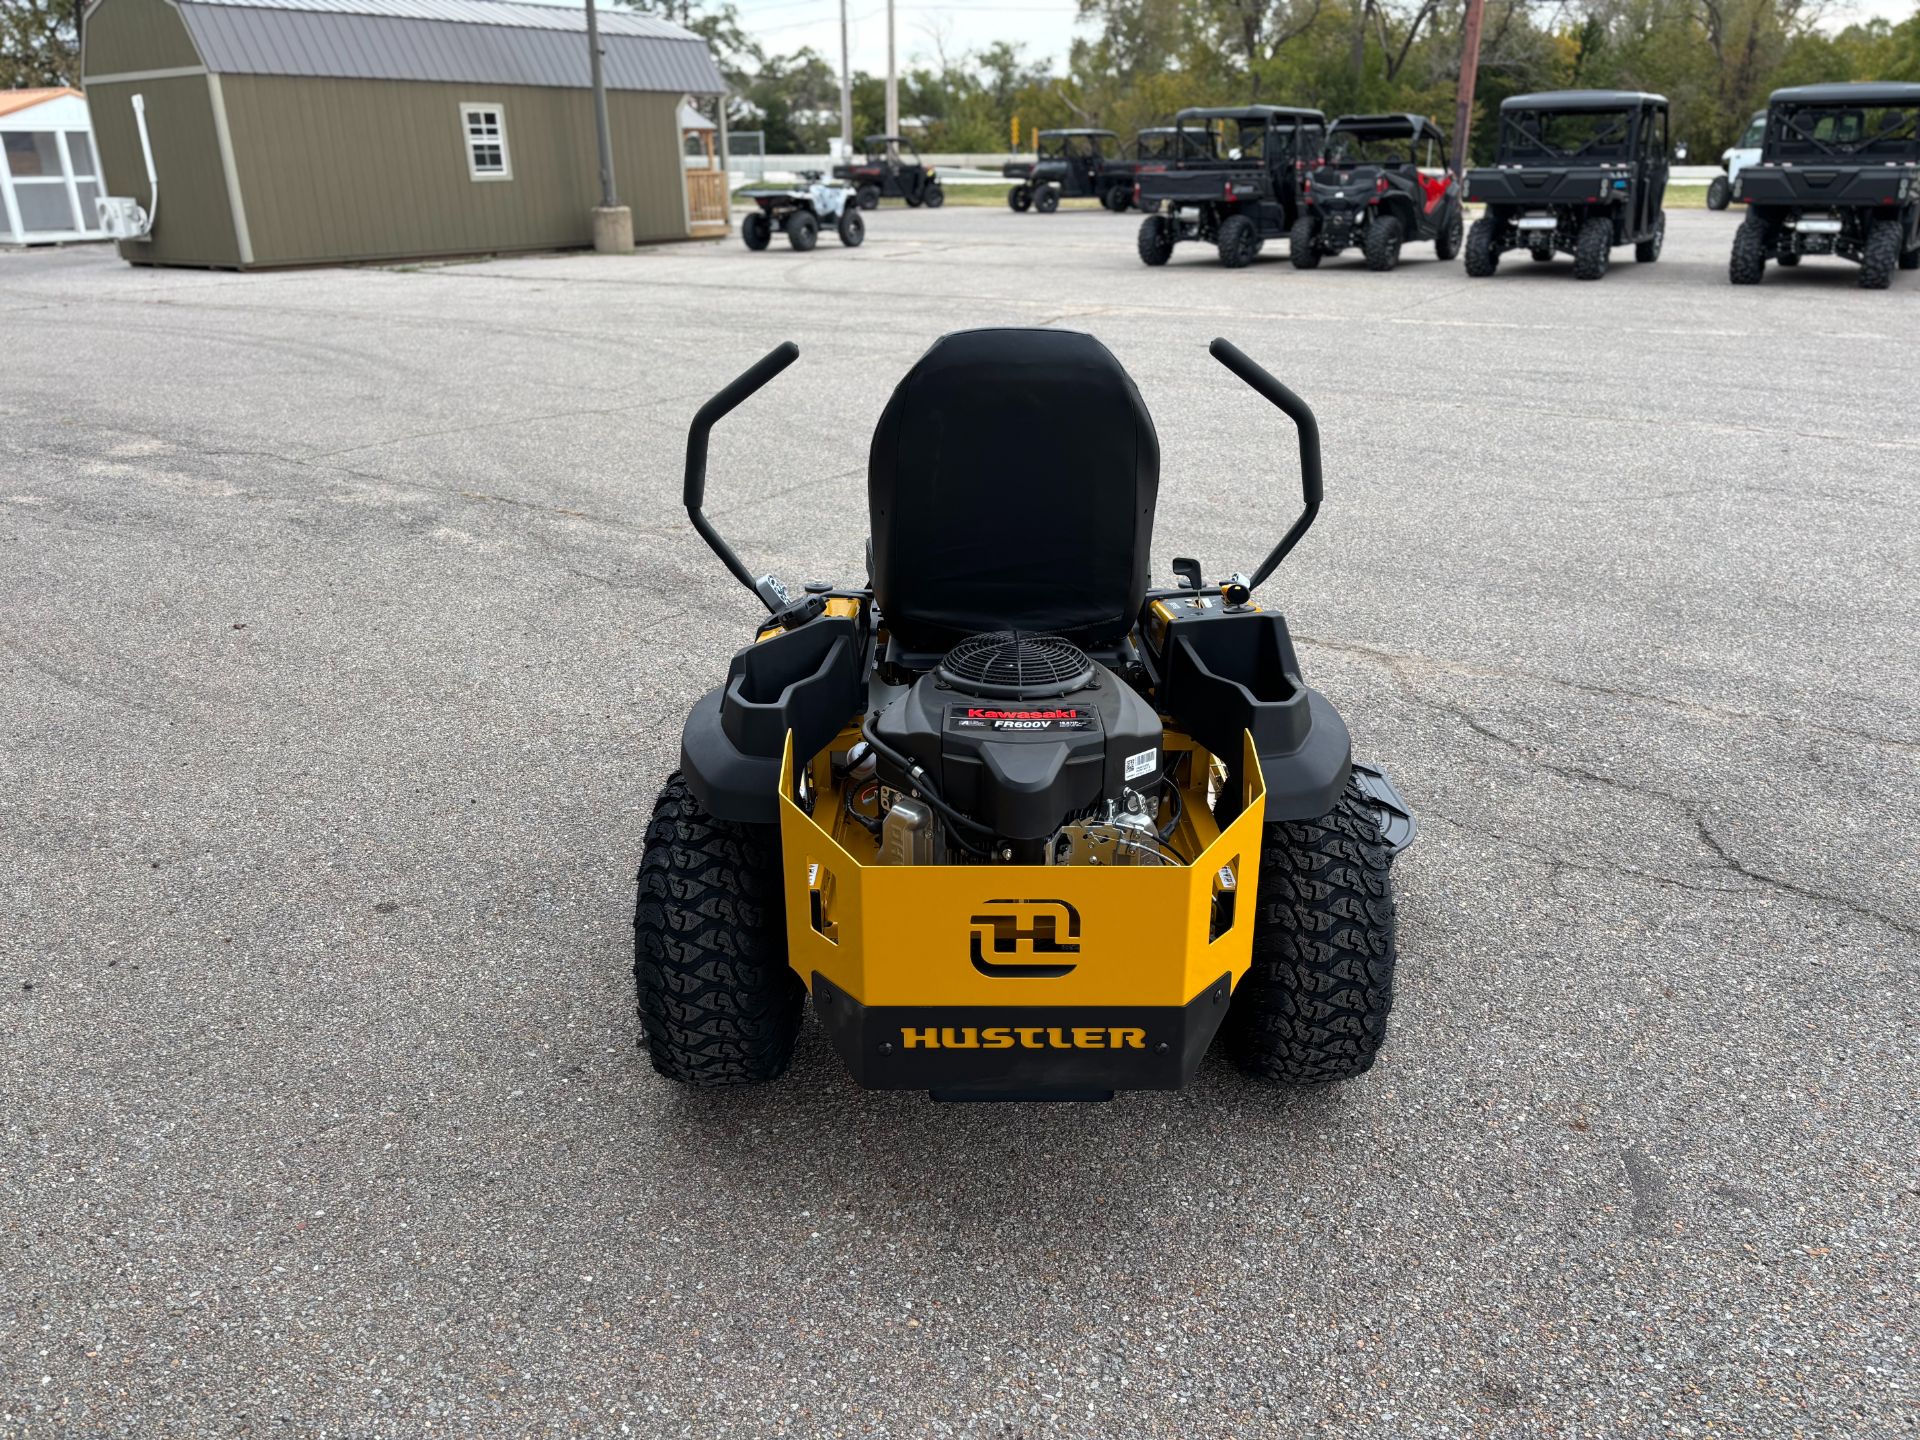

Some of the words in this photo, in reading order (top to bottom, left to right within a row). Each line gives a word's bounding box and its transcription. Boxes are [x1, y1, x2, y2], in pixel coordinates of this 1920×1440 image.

[968, 708, 1077, 719] Kawasaki
[994, 721, 1052, 729] FR600V
[901, 1027, 1146, 1048] HUSTLER
